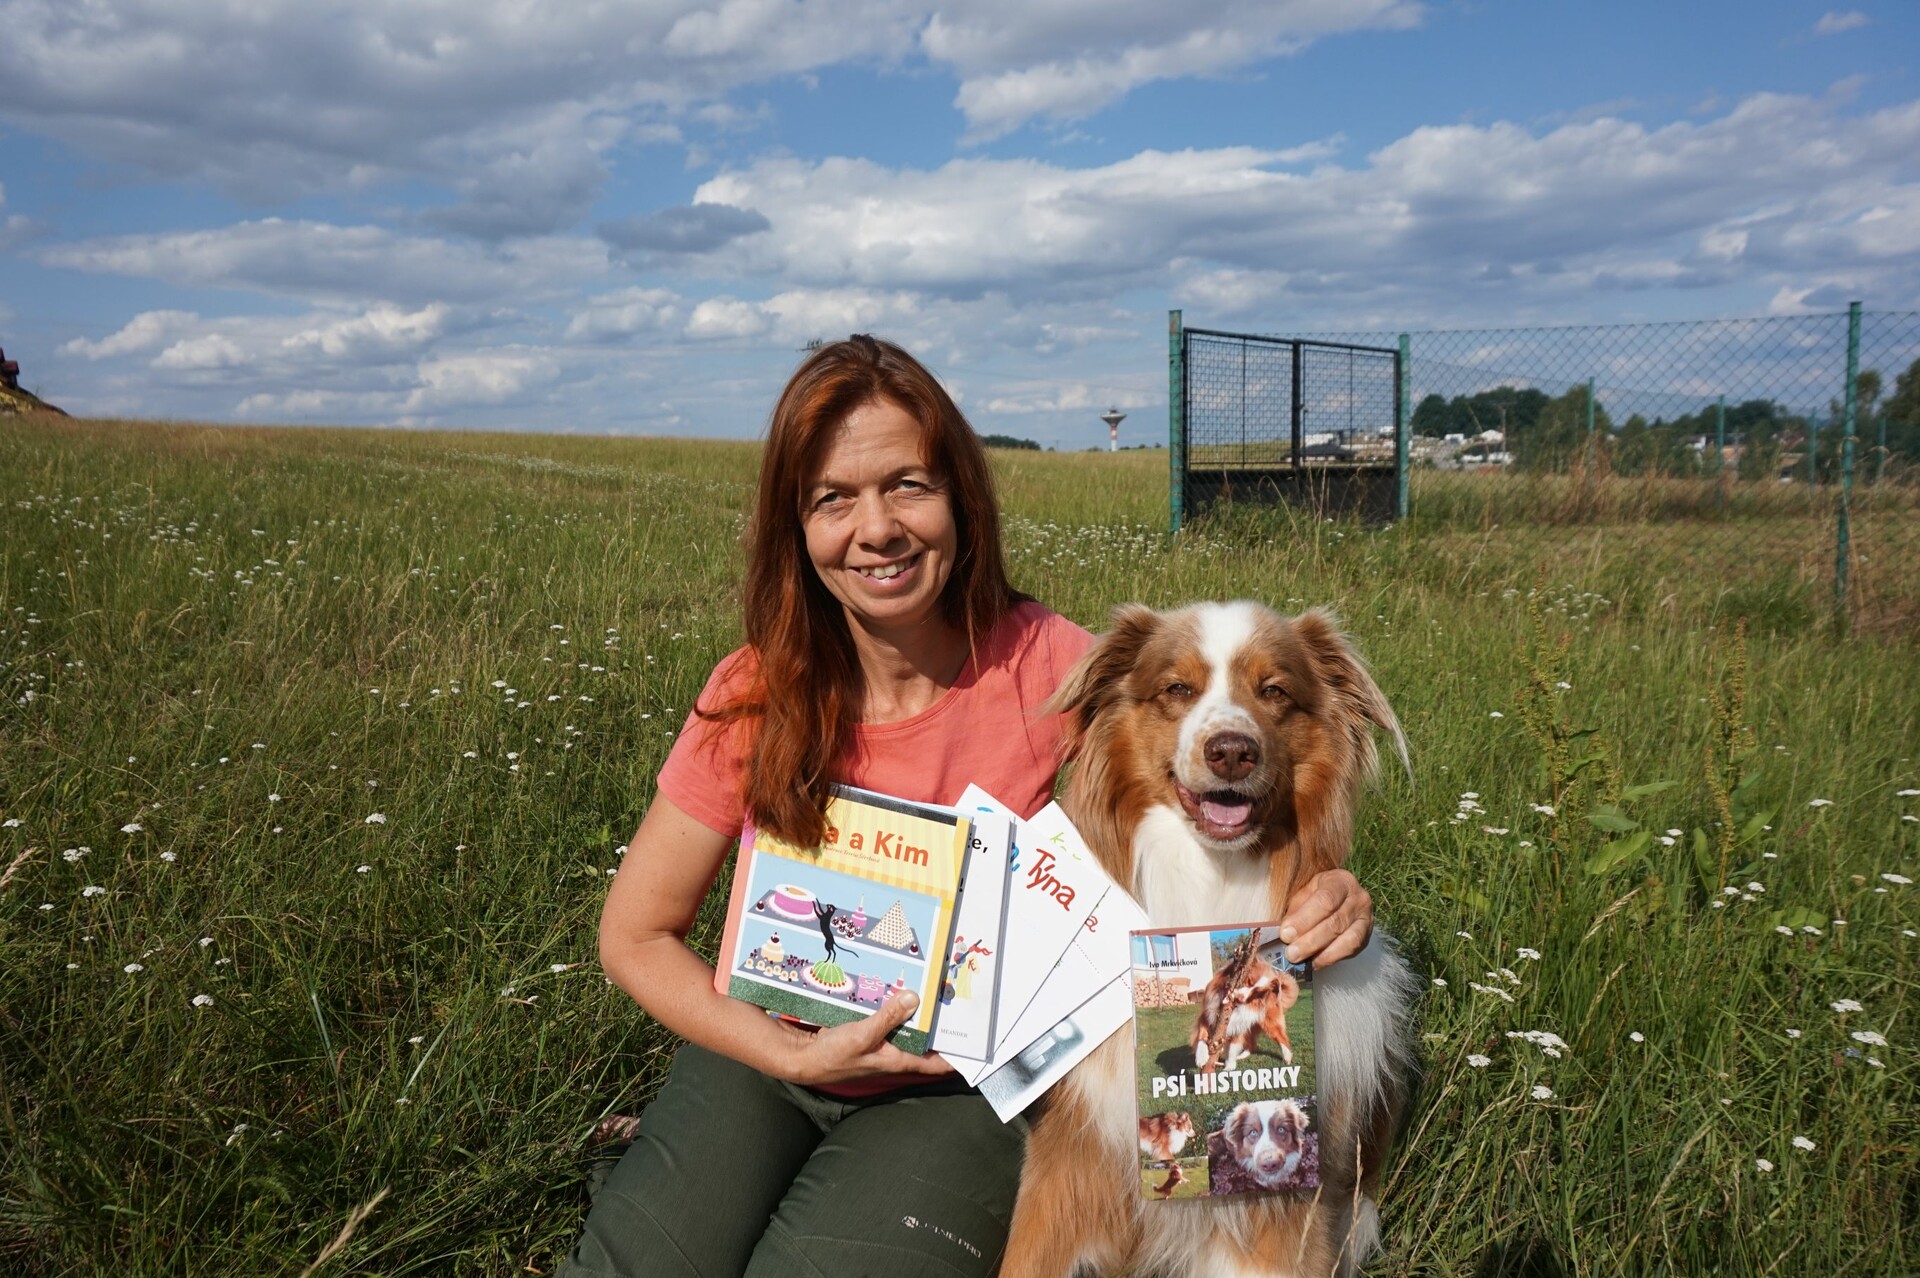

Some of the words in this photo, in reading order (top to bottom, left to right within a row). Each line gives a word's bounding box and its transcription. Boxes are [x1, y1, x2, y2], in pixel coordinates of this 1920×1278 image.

[849, 832, 864, 850] a
[874, 830, 929, 867] Kim
[1026, 848, 1076, 911] Týna
[940, 1028, 968, 1038] MEANDER
[1152, 1069, 1187, 1098] PSÍ
[1194, 1065, 1301, 1095] HISTORKY
